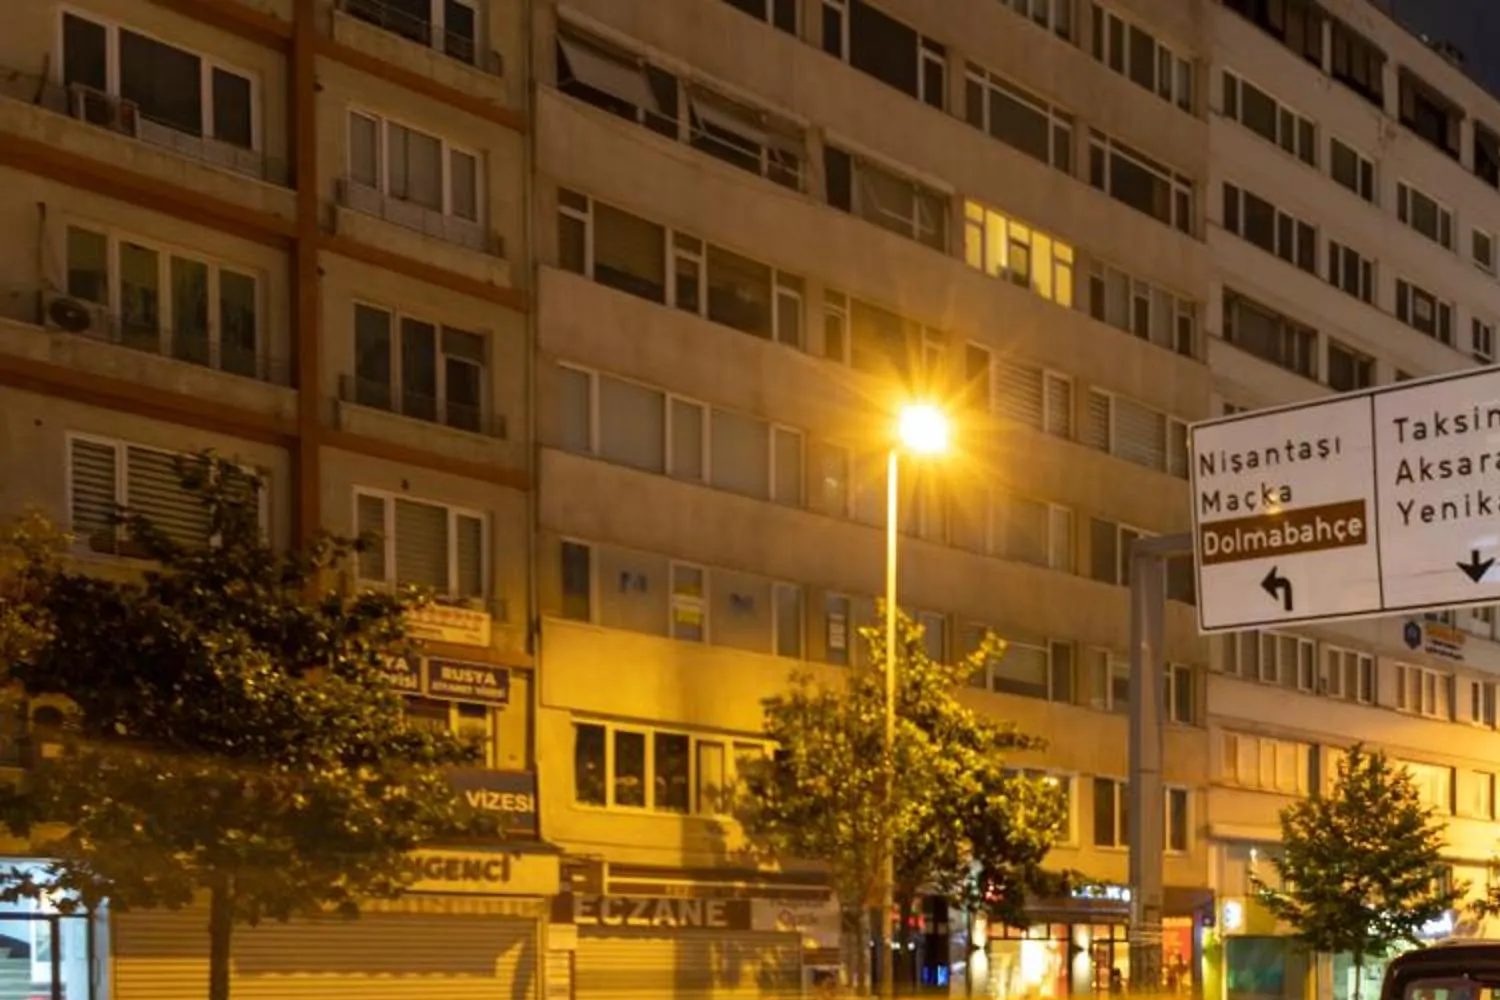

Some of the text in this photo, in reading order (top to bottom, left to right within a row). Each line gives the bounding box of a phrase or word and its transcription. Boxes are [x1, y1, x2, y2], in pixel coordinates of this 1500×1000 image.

[1200, 435, 1341, 476] Nişantaşı
[1202, 480, 1292, 515] Maçka
[1203, 512, 1364, 556] Dolmabahçe
[465, 788, 535, 813] VİZESİ
[573, 895, 728, 928] ECZANE
